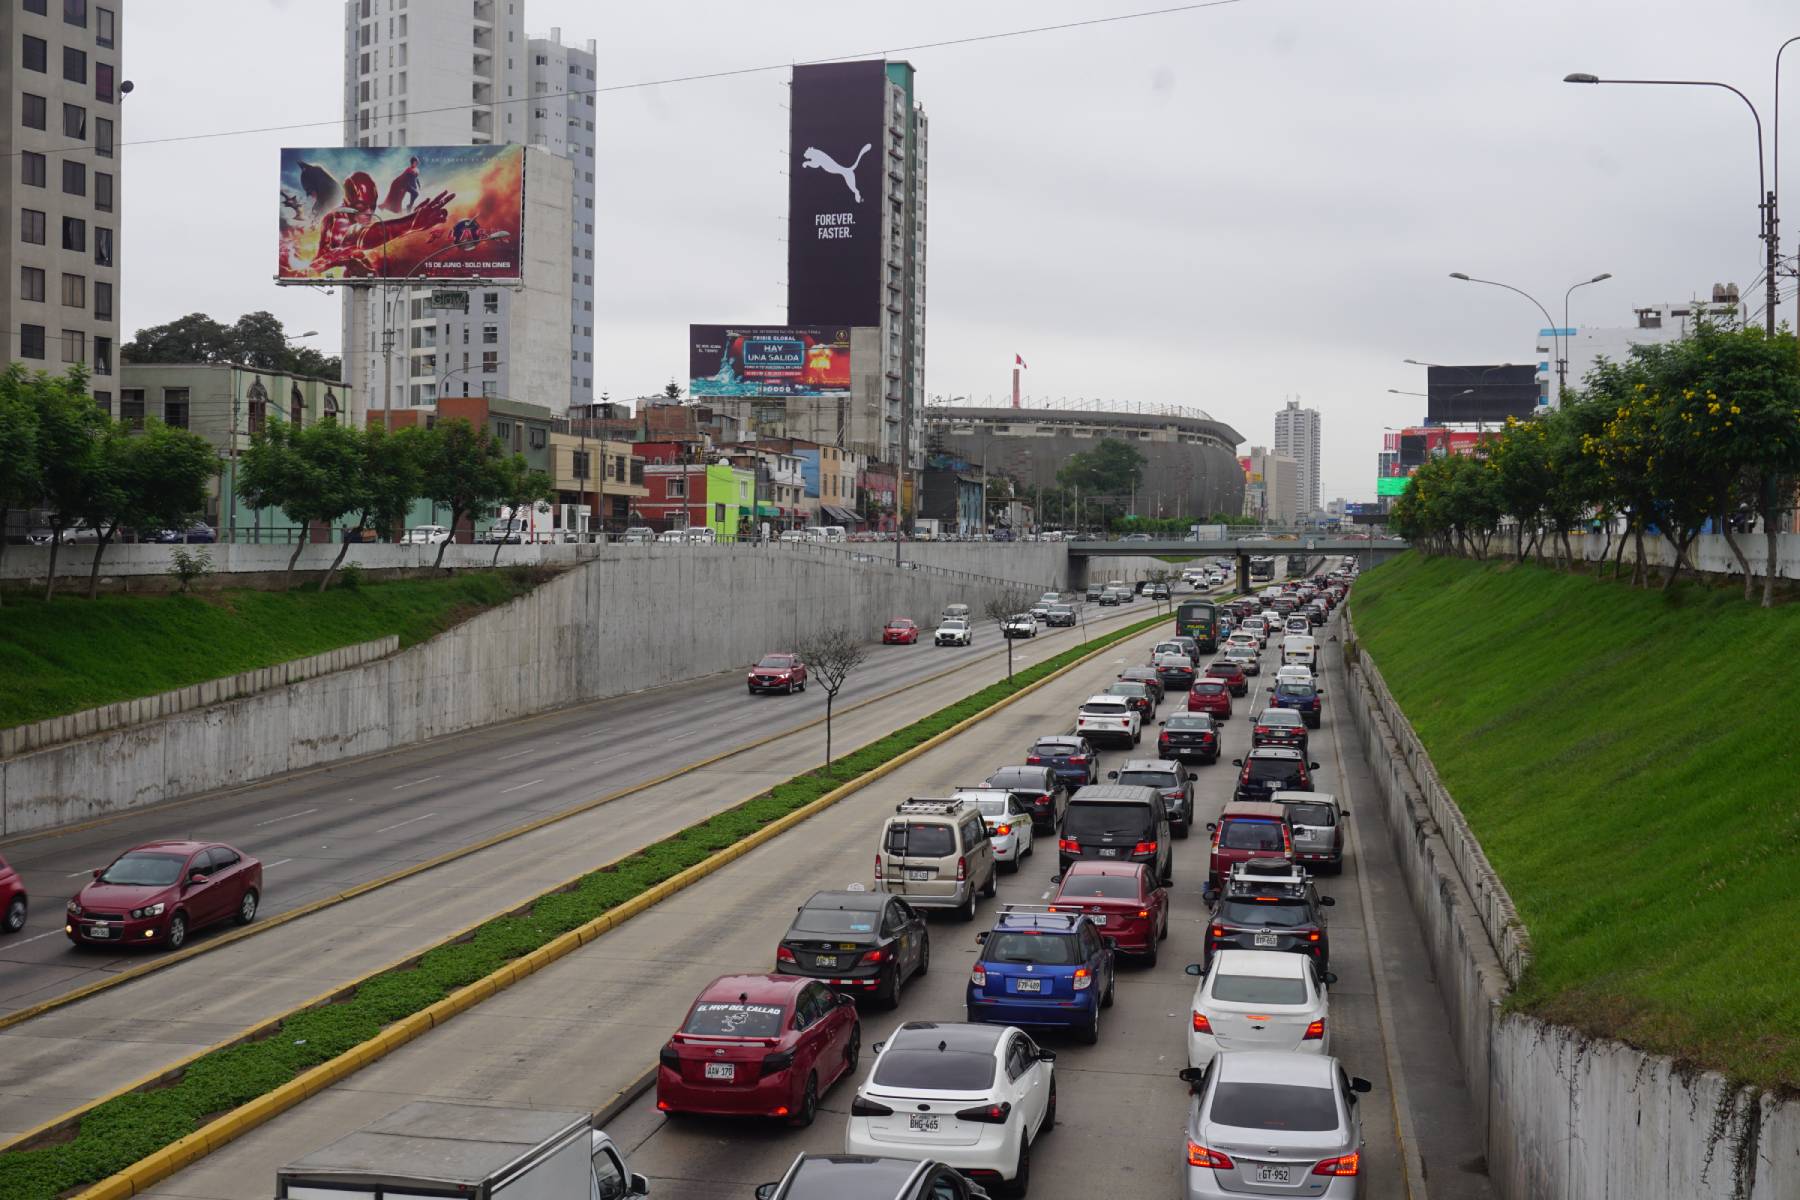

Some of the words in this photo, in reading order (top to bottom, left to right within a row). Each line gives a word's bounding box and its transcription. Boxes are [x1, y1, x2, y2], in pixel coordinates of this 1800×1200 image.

[815, 213, 856, 226] FOREVER.
[818, 226, 852, 239] FASTER.
[697, 1004, 706, 1012] EL
[746, 1005, 781, 1015] CALLAO
[910, 1119, 938, 1129] BHG-465
